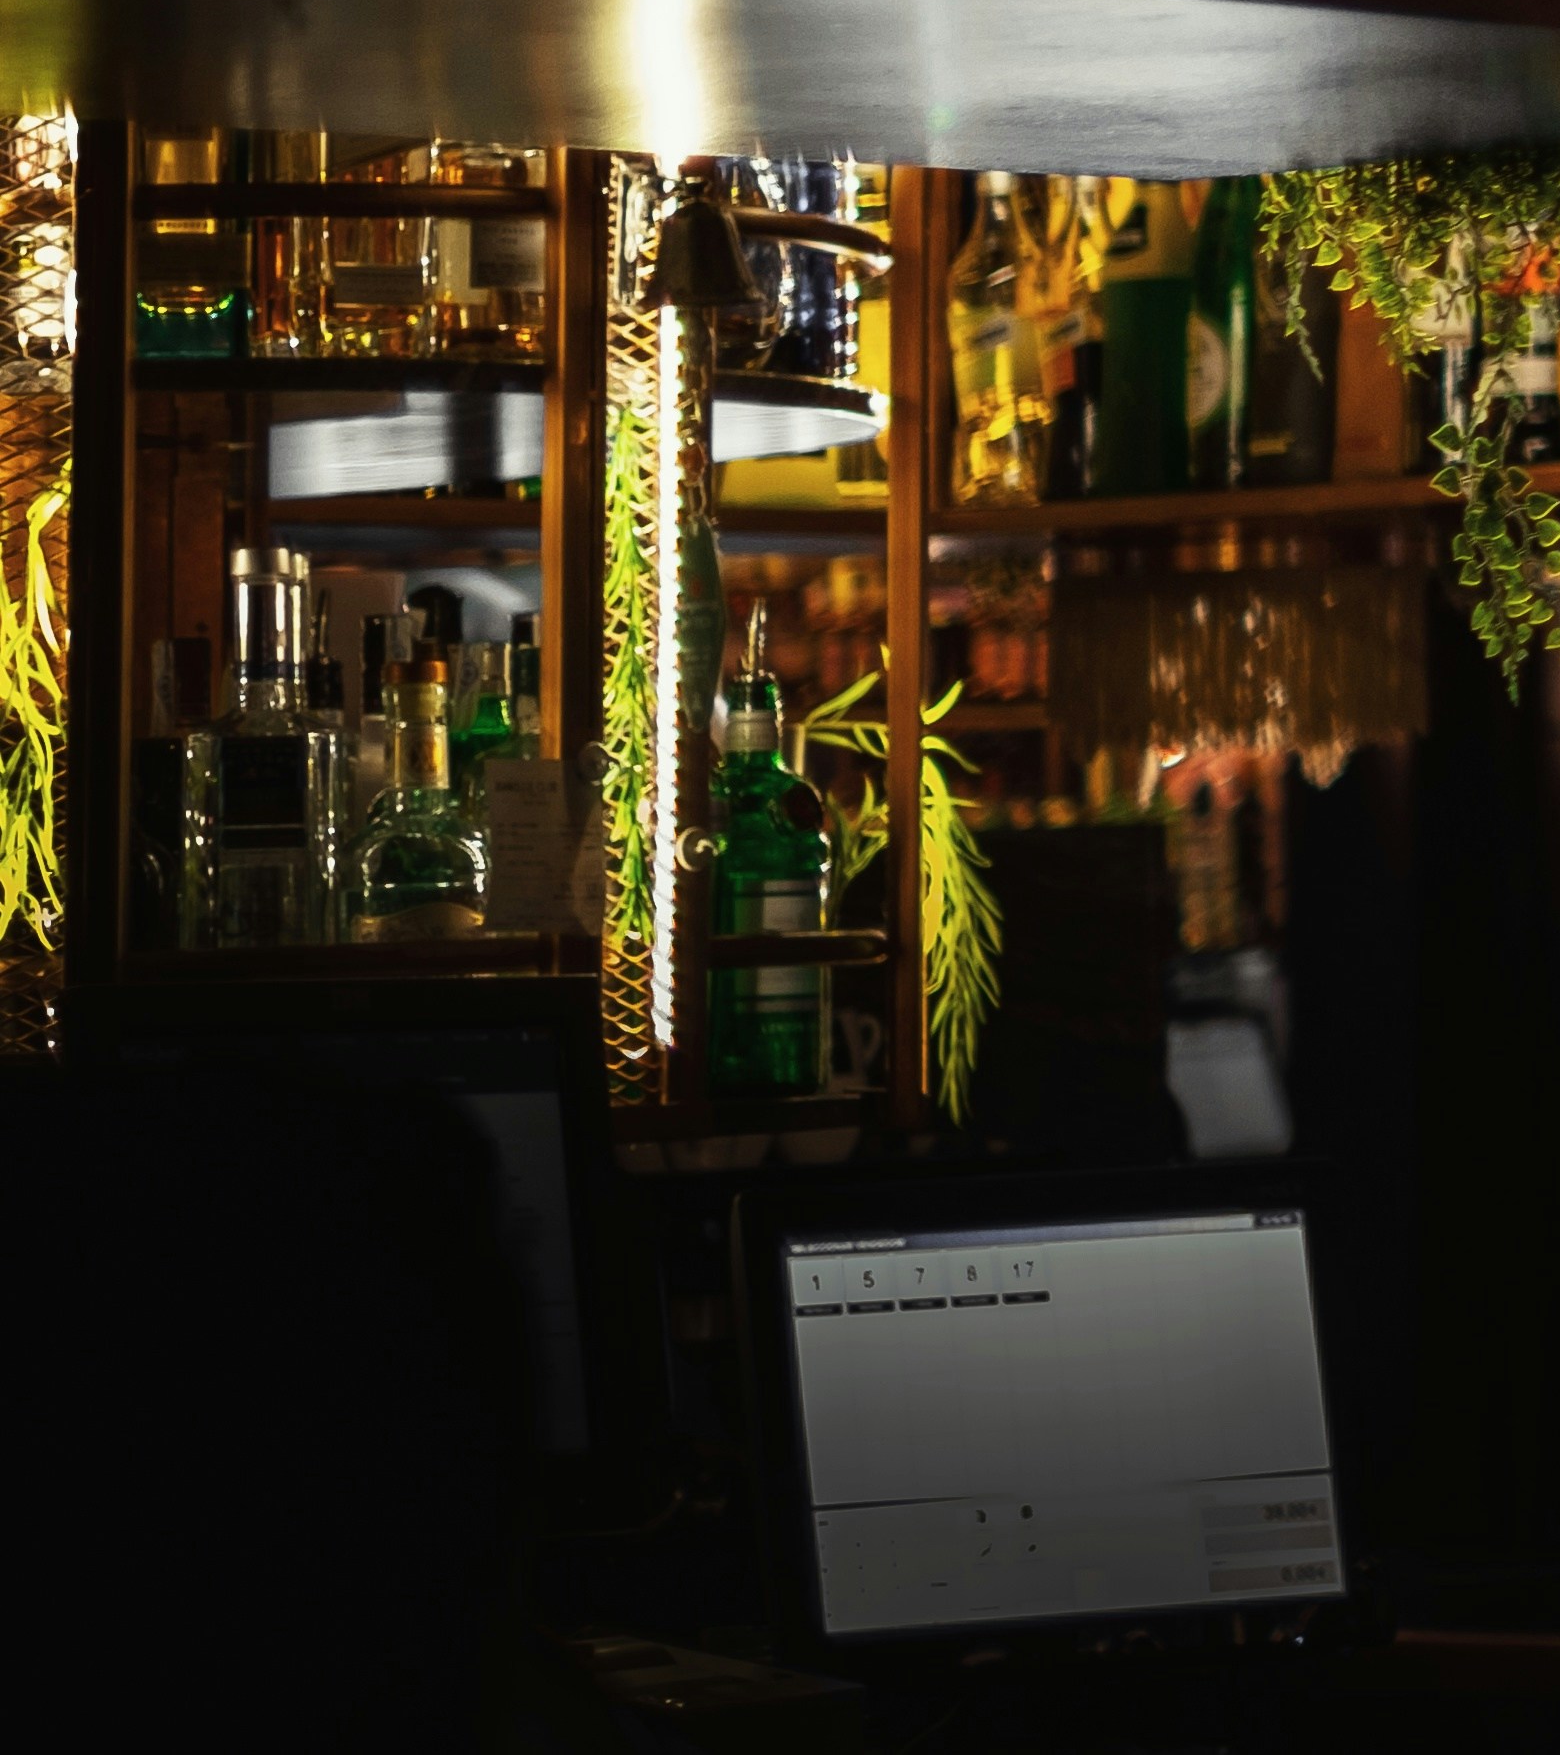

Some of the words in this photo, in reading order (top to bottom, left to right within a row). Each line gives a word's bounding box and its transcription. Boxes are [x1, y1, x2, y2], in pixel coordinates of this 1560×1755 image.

[811, 1274, 821, 1291] 1
[862, 1269, 876, 1289] 5
[914, 1266, 925, 1285] 7
[1012, 1260, 1035, 1279] 17
